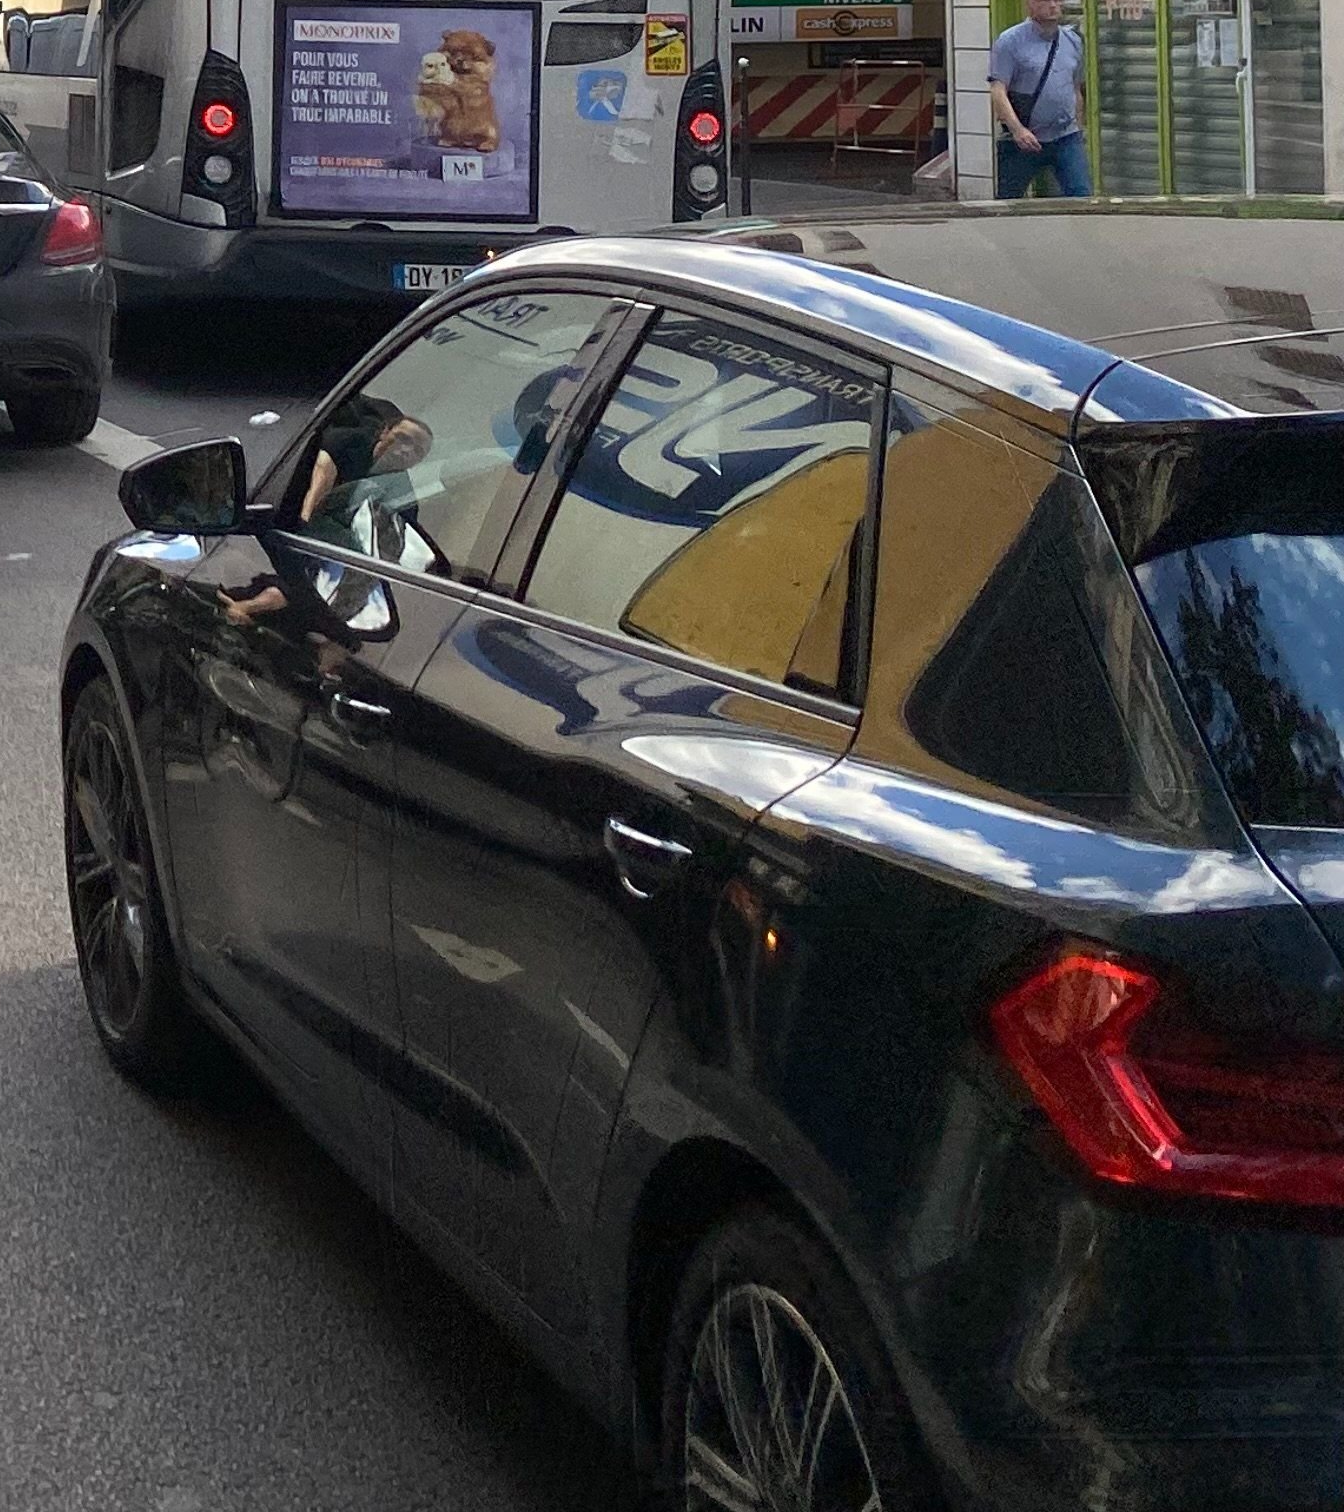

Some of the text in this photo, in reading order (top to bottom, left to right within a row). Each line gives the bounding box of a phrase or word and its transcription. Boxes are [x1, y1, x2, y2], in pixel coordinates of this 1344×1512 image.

[298, 23, 395, 41] MONOPRIX
[292, 51, 359, 68] POUR VOUS
[292, 69, 326, 86] FAIRE
[291, 88, 309, 104] ON
[372, 90, 389, 106] UN
[292, 106, 392, 126] TRUC IMPARABLE
